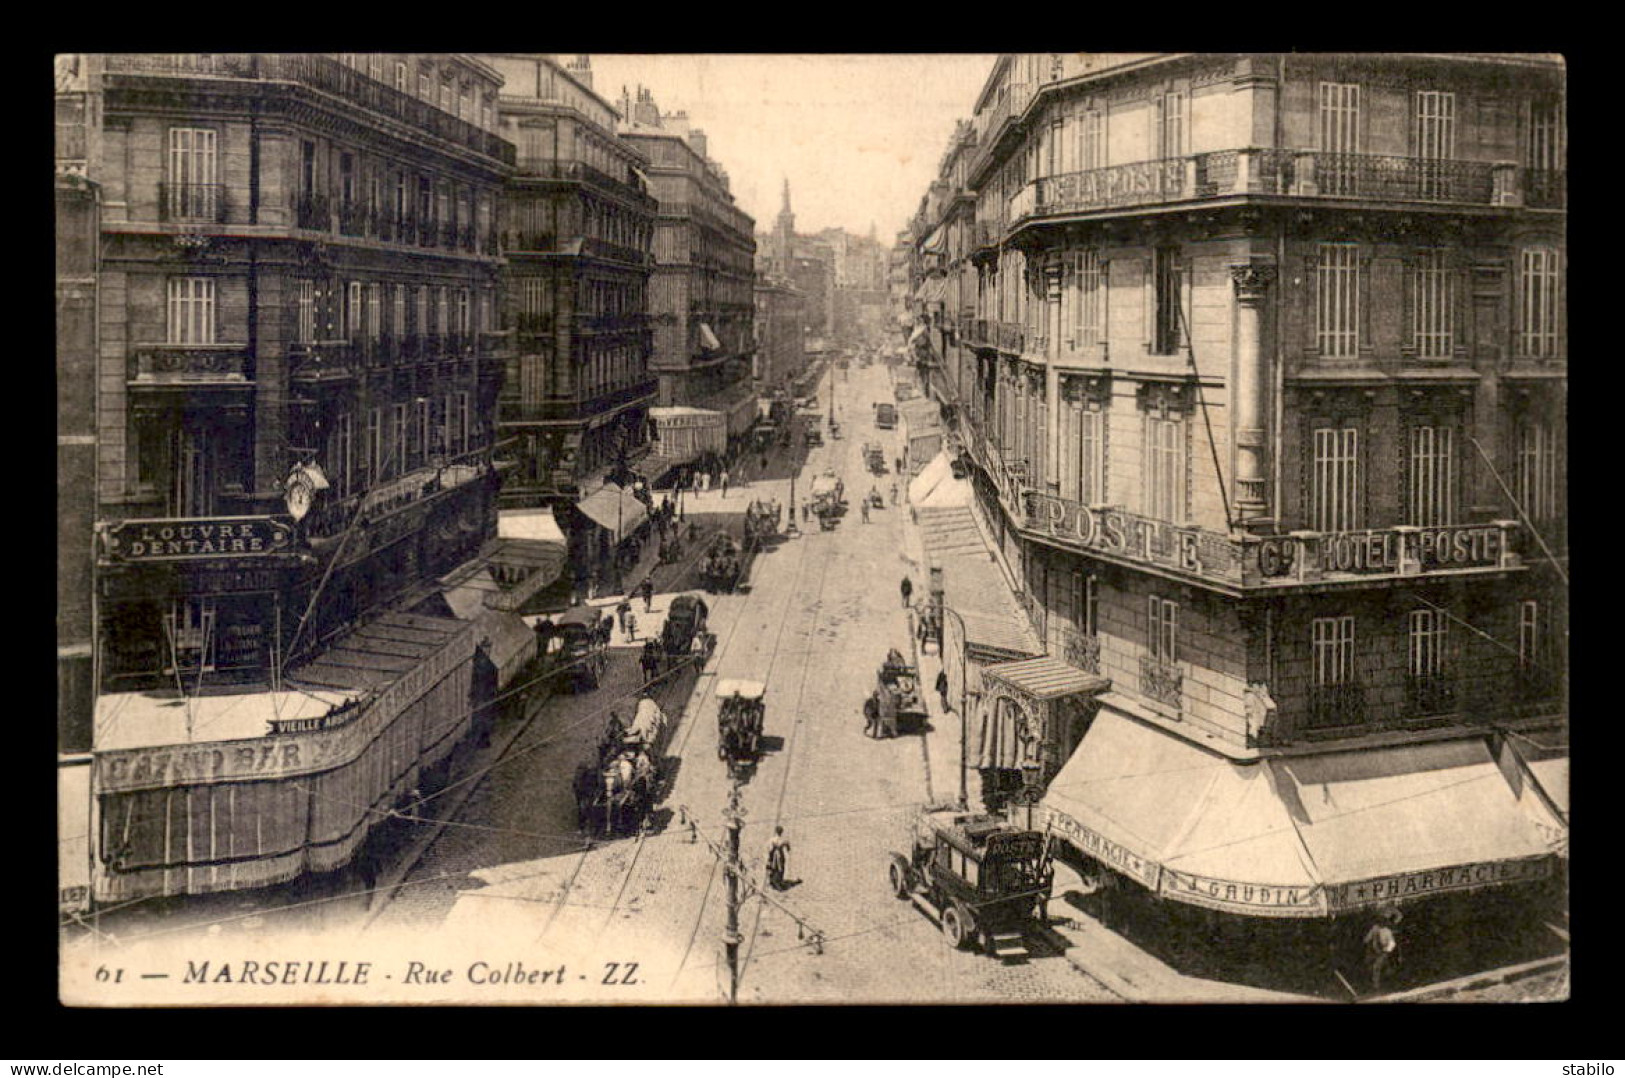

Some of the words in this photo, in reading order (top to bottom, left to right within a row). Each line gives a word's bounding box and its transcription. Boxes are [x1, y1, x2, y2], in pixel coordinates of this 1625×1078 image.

[1106, 161, 1182, 199] POSTE
[132, 538, 262, 555] DENTAIRE
[142, 524, 253, 540] LOUVRE
[1048, 499, 1202, 575] POSTE
[1420, 528, 1499, 563] POSTE
[278, 719, 319, 733] VIEILLE
[235, 744, 300, 771] BAR
[1058, 813, 1133, 868] PHARMACIE
[1209, 881, 1299, 905] GAUDIN
[1373, 862, 1513, 898] PHARMACIE
